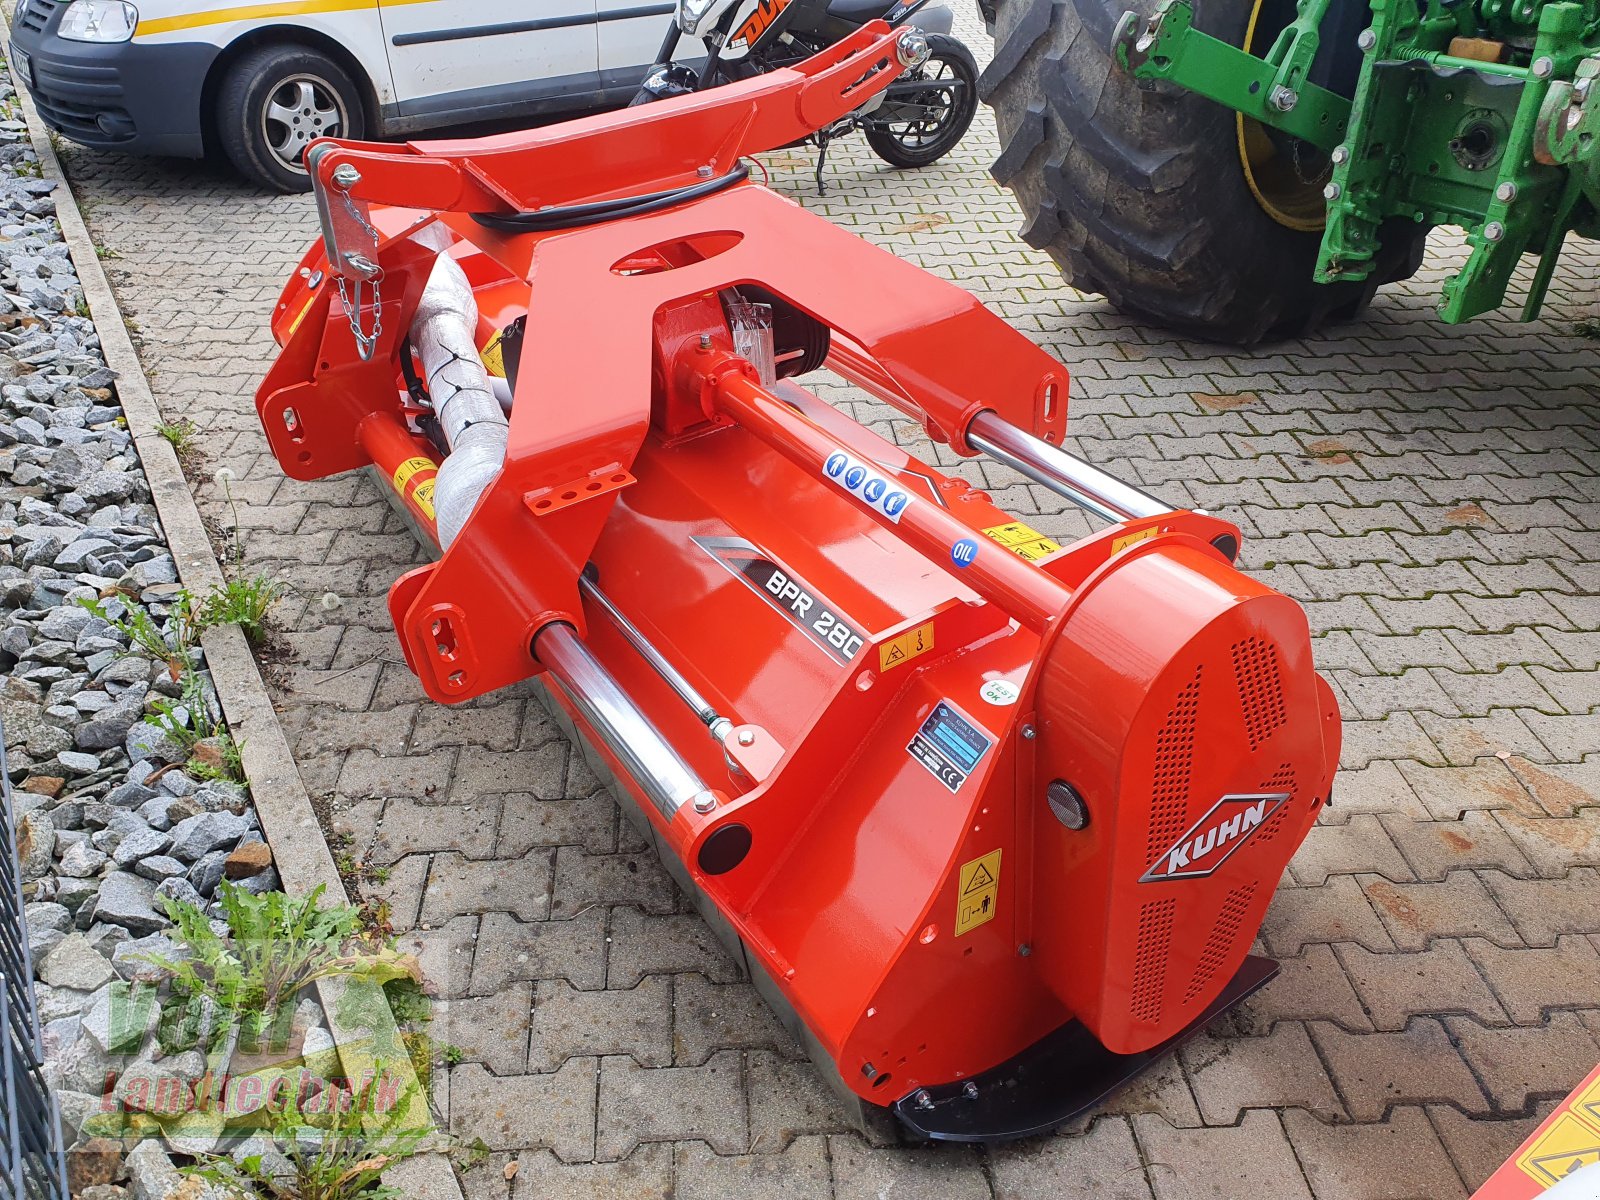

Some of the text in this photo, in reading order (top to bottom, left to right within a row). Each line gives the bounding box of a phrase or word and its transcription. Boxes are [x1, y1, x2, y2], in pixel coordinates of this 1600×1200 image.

[953, 542, 972, 562] OIL
[765, 569, 814, 619] BPR
[986, 691, 1000, 701] OK
[991, 682, 1016, 699] TEST
[1167, 799, 1267, 875] KUHN
